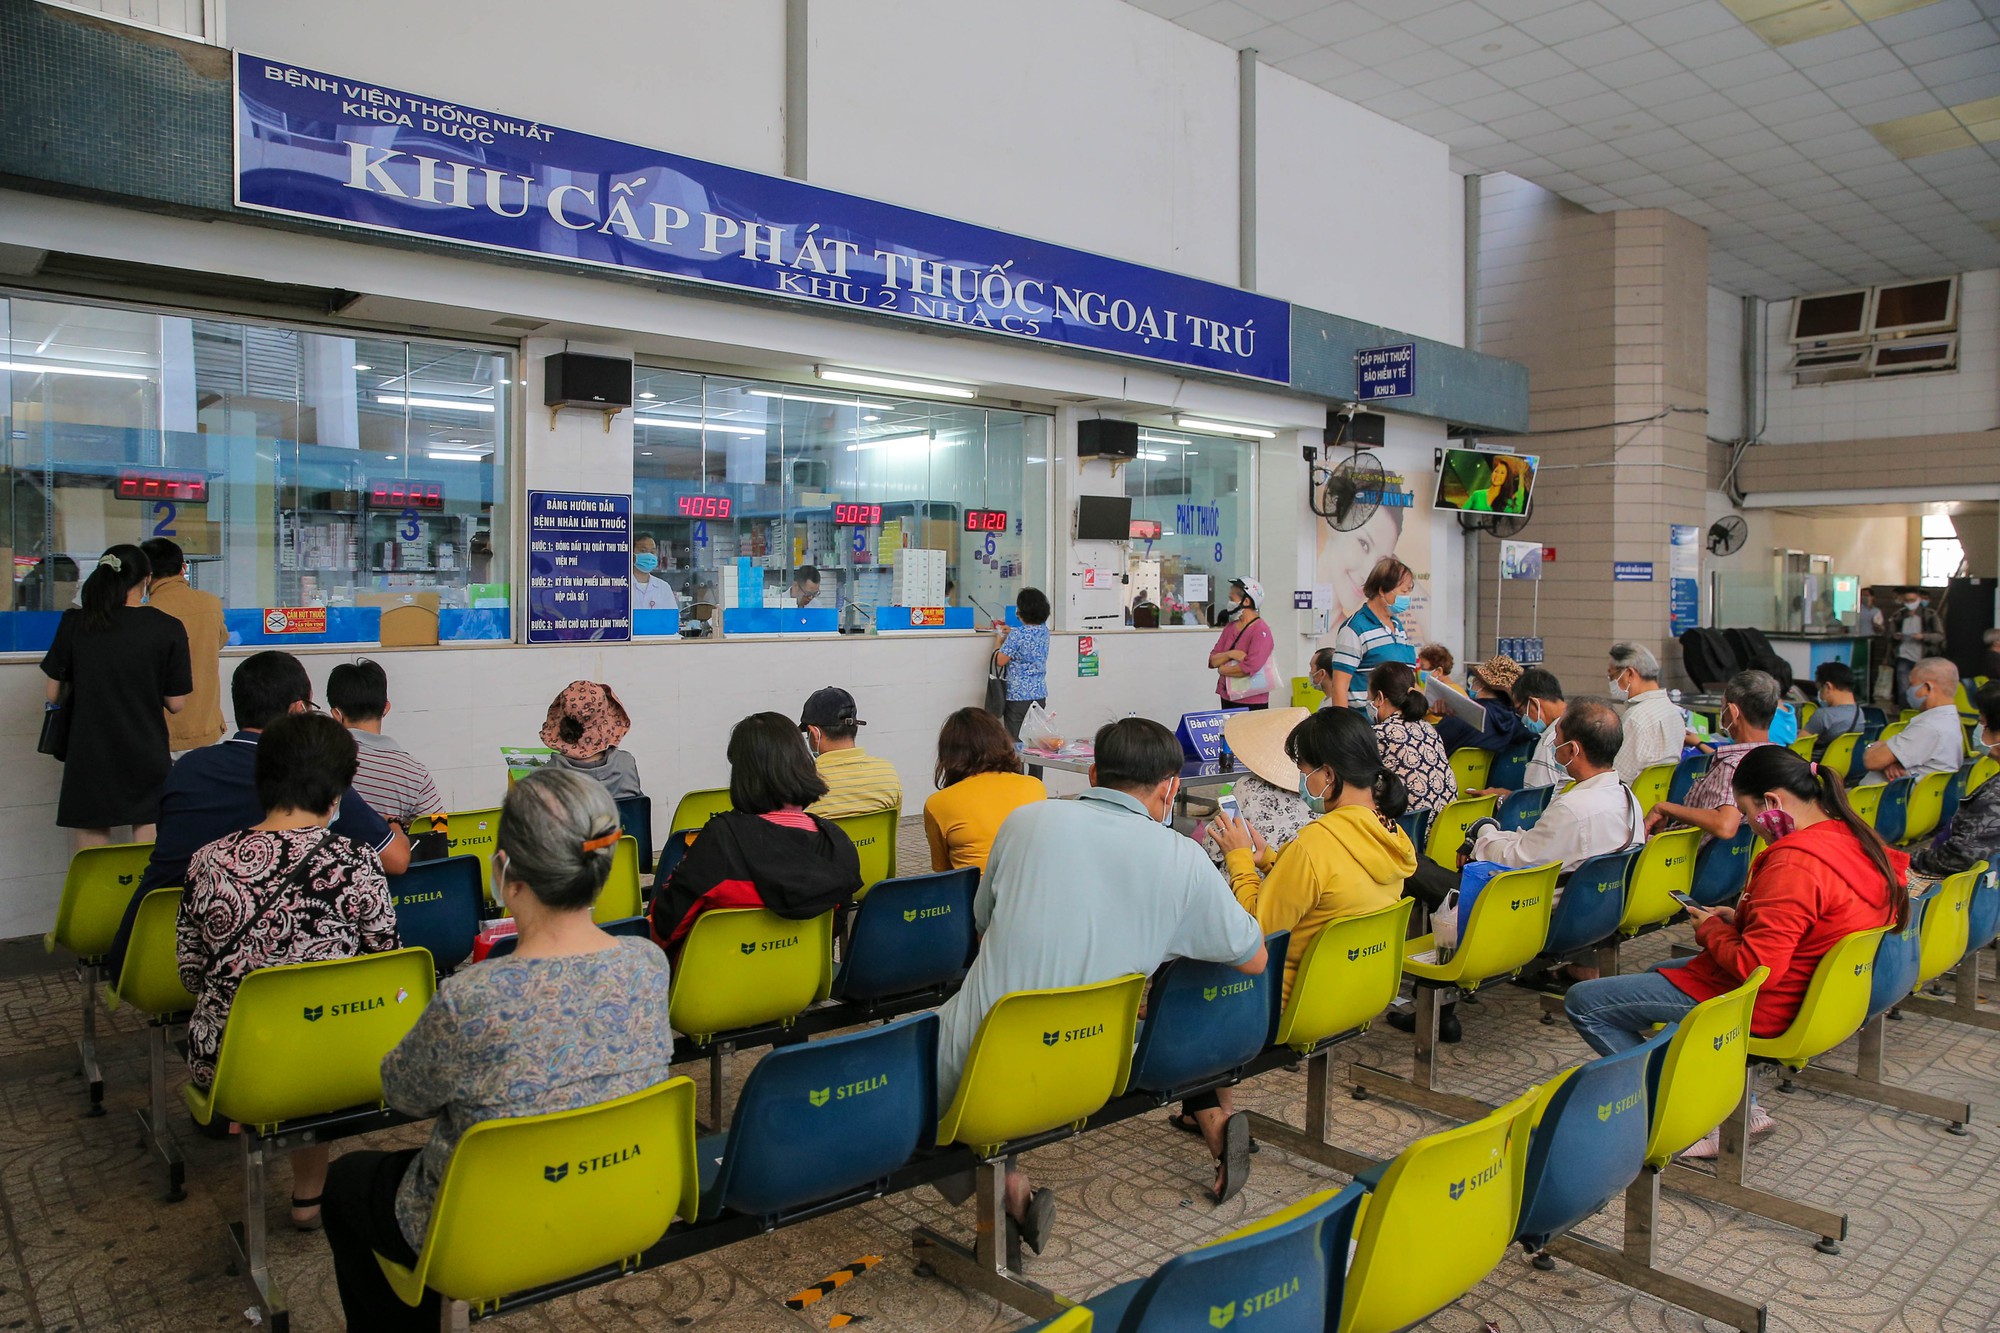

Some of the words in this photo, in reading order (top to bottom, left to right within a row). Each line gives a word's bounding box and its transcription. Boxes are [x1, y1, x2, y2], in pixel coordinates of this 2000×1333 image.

[264, 65, 338, 94] BỆNH
[343, 83, 401, 109] VIỆN
[406, 98, 489, 129] THỐNG
[494, 119, 555, 143] NHẤT
[341, 102, 413, 129] KHOA
[423, 118, 495, 146] DƯỢC
[342, 140, 536, 217] KHU
[547, 177, 689, 246] CẤP
[700, 211, 859, 279] PHÁT
[874, 249, 1045, 315] THUỐC
[1052, 285, 1179, 344] NGOẠI
[1185, 315, 1257, 358] TRÚ
[776, 270, 872, 305] KHU
[878, 290, 898, 310] 2
[910, 295, 994, 329] NHÀ
[999, 313, 1041, 336] C5
[1360, 352, 1372, 366] CẤP
[1373, 351, 1389, 364] PHÁT
[1390, 347, 1410, 362] THUỐC
[1364, 368, 1376, 382] BẢO
[1377, 364, 1392, 380] HIỂM
[1393, 368, 1398, 378] Y
[1398, 364, 1406, 378] TẾ
[1374, 384, 1389, 396] (KHU
[1390, 383, 1396, 394] 2)
[546, 498, 568, 510] BẢNG
[570, 500, 596, 512] HƯỚNG
[599, 499, 614, 512] DẪN
[680, 496, 731, 518] 4059
[836, 504, 882, 524] 5029
[153, 501, 177, 537] 2
[401, 508, 420, 541] 3
[534, 514, 555, 528] BỆNH
[558, 516, 578, 528] NHÂN
[581, 516, 598, 528] LĨNH
[601, 516, 626, 529] THUỐC
[968, 512, 1006, 530] 6120
[1177, 498, 1194, 535] PHÁT
[1197, 499, 1220, 536] THUỐC
[693, 519, 708, 548] 4
[853, 526, 866, 552] 5
[532, 540, 546, 550] BƯỚC
[548, 542, 554, 550] 1:
[985, 532, 996, 556] 6
[1144, 538, 1154, 560] 7
[1214, 542, 1222, 562] 8
[532, 576, 546, 586] BƯỚC
[531, 619, 546, 630] BƯỚC
[1190, 719, 1208, 728] Bàn
[1208, 718, 1224, 727] dàn
[1204, 747, 1216, 756] Ký
[462, 836, 492, 846] STELLA
[404, 890, 442, 905] STELLA
[1521, 895, 1540, 908] STELLA
[920, 904, 952, 918] STELLA
[761, 936, 799, 952] STELLA
[1362, 940, 1387, 958] STELLA
[1222, 979, 1253, 996] STELLA
[331, 996, 385, 1017] STELLA
[1064, 1023, 1104, 1043] STELLA
[837, 1074, 889, 1100] STELLA
[1615, 1089, 1642, 1114] STELLA
[578, 1143, 642, 1176] STELLA
[1470, 1158, 1503, 1191] STELLA
[1242, 1276, 1300, 1319] STELLA
